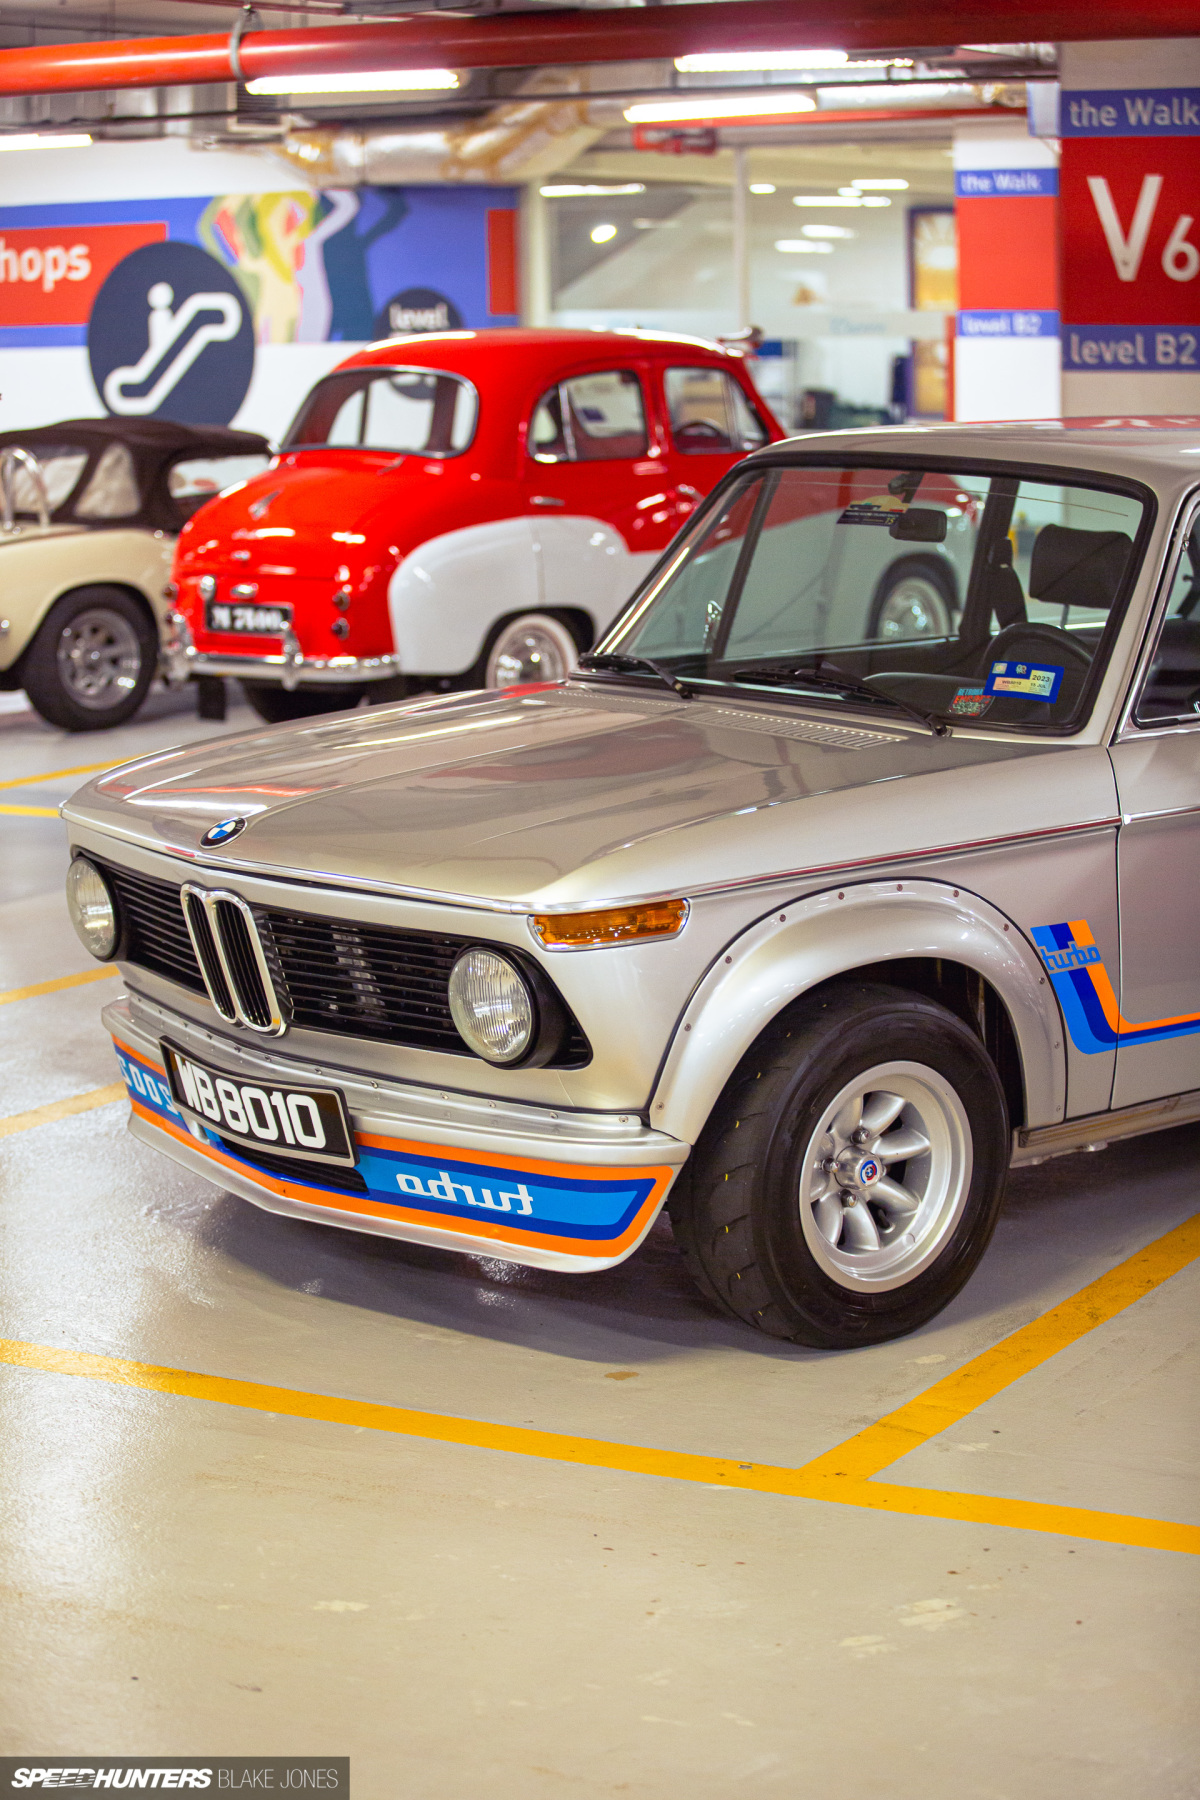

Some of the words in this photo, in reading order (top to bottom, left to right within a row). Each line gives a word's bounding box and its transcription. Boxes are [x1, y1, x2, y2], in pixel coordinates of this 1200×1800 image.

[1069, 98, 1118, 128] the
[1123, 97, 1200, 126] Walk
[1070, 333, 1148, 365] level
[1155, 333, 1197, 365] B2
[1032, 674, 1051, 683] 2023
[1040, 943, 1101, 971] turbo
[174, 1053, 327, 1149] WB8010
